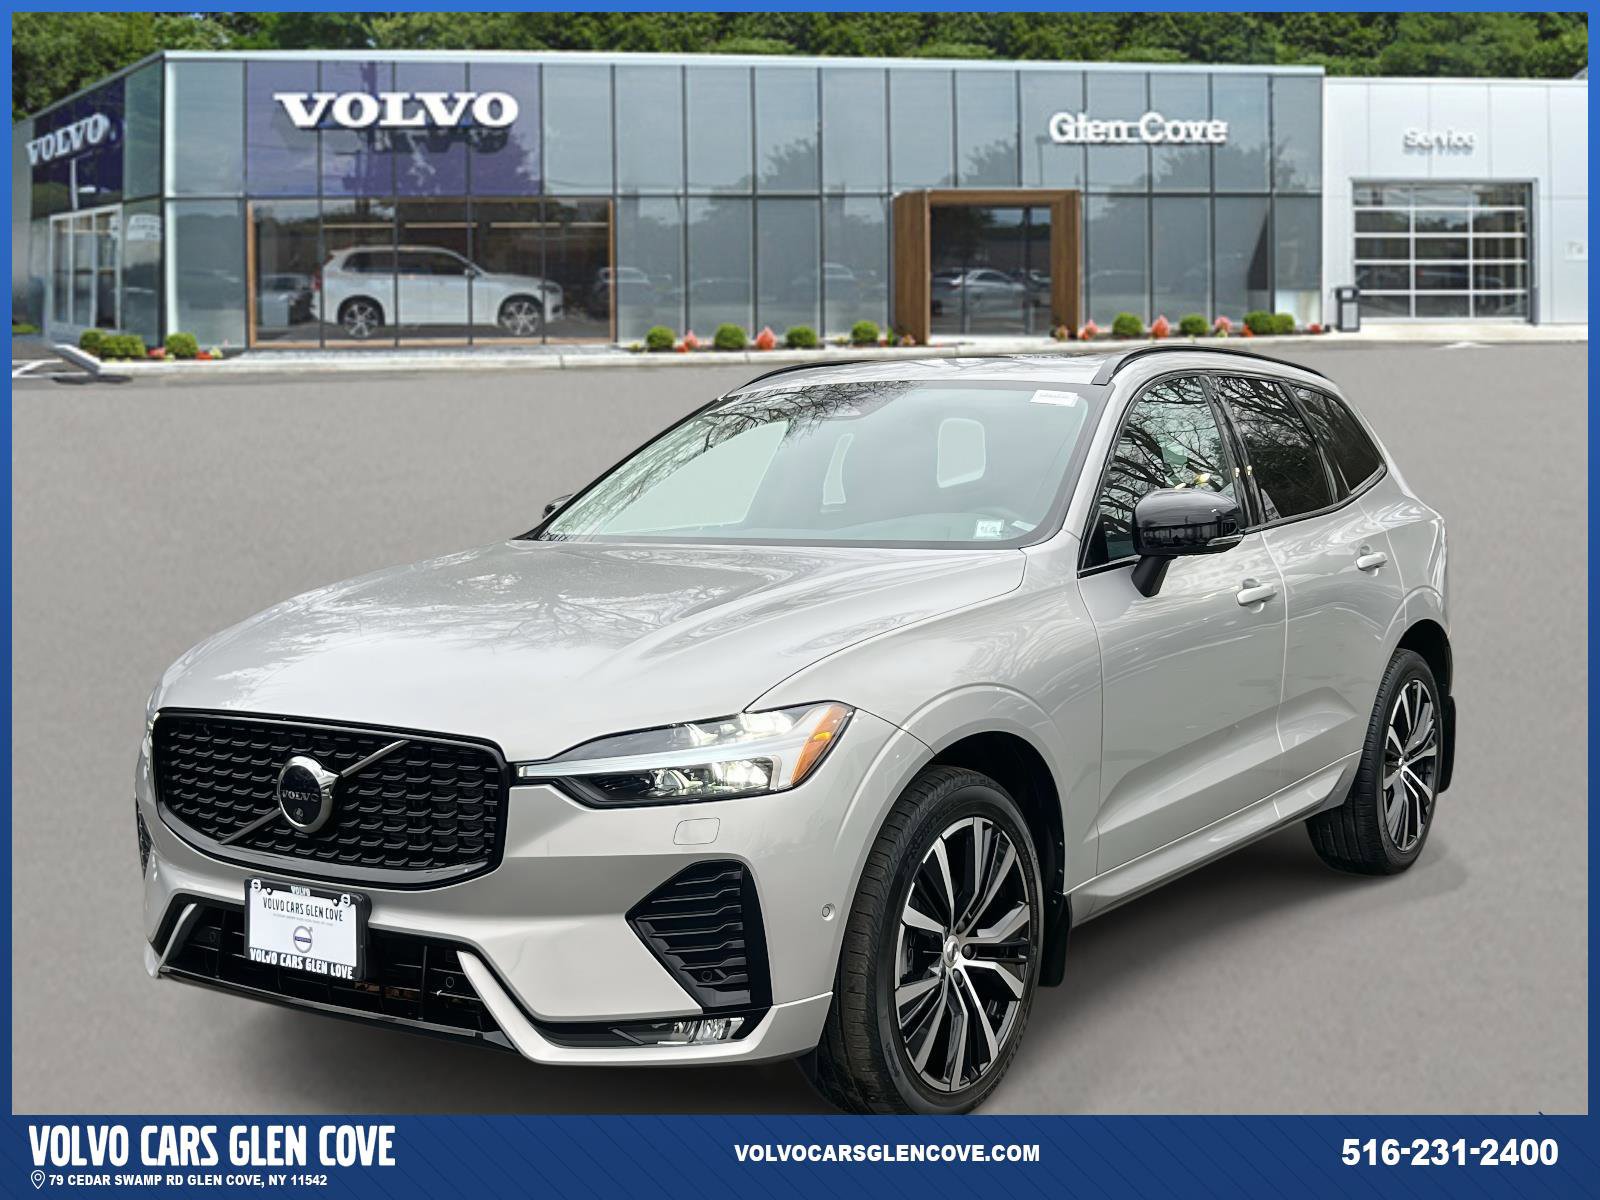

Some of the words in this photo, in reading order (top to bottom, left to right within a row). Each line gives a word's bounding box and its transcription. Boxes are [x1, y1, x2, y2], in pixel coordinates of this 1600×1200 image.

[274, 92, 519, 128] VOLVO
[25, 113, 110, 165] VOLVO
[1049, 112, 1130, 143] Glen
[1139, 112, 1228, 143] Cove
[1403, 128, 1476, 153] Service
[280, 789, 320, 802] VOLVO
[290, 885, 311, 897] VOLVO
[263, 897, 285, 912] VOLVO
[286, 901, 304, 915] CARS
[305, 904, 324, 919] GLEN
[325, 907, 344, 922] COVE
[249, 947, 278, 965] VOLVO
[279, 953, 303, 970] CARS
[305, 957, 328, 975] GLEN
